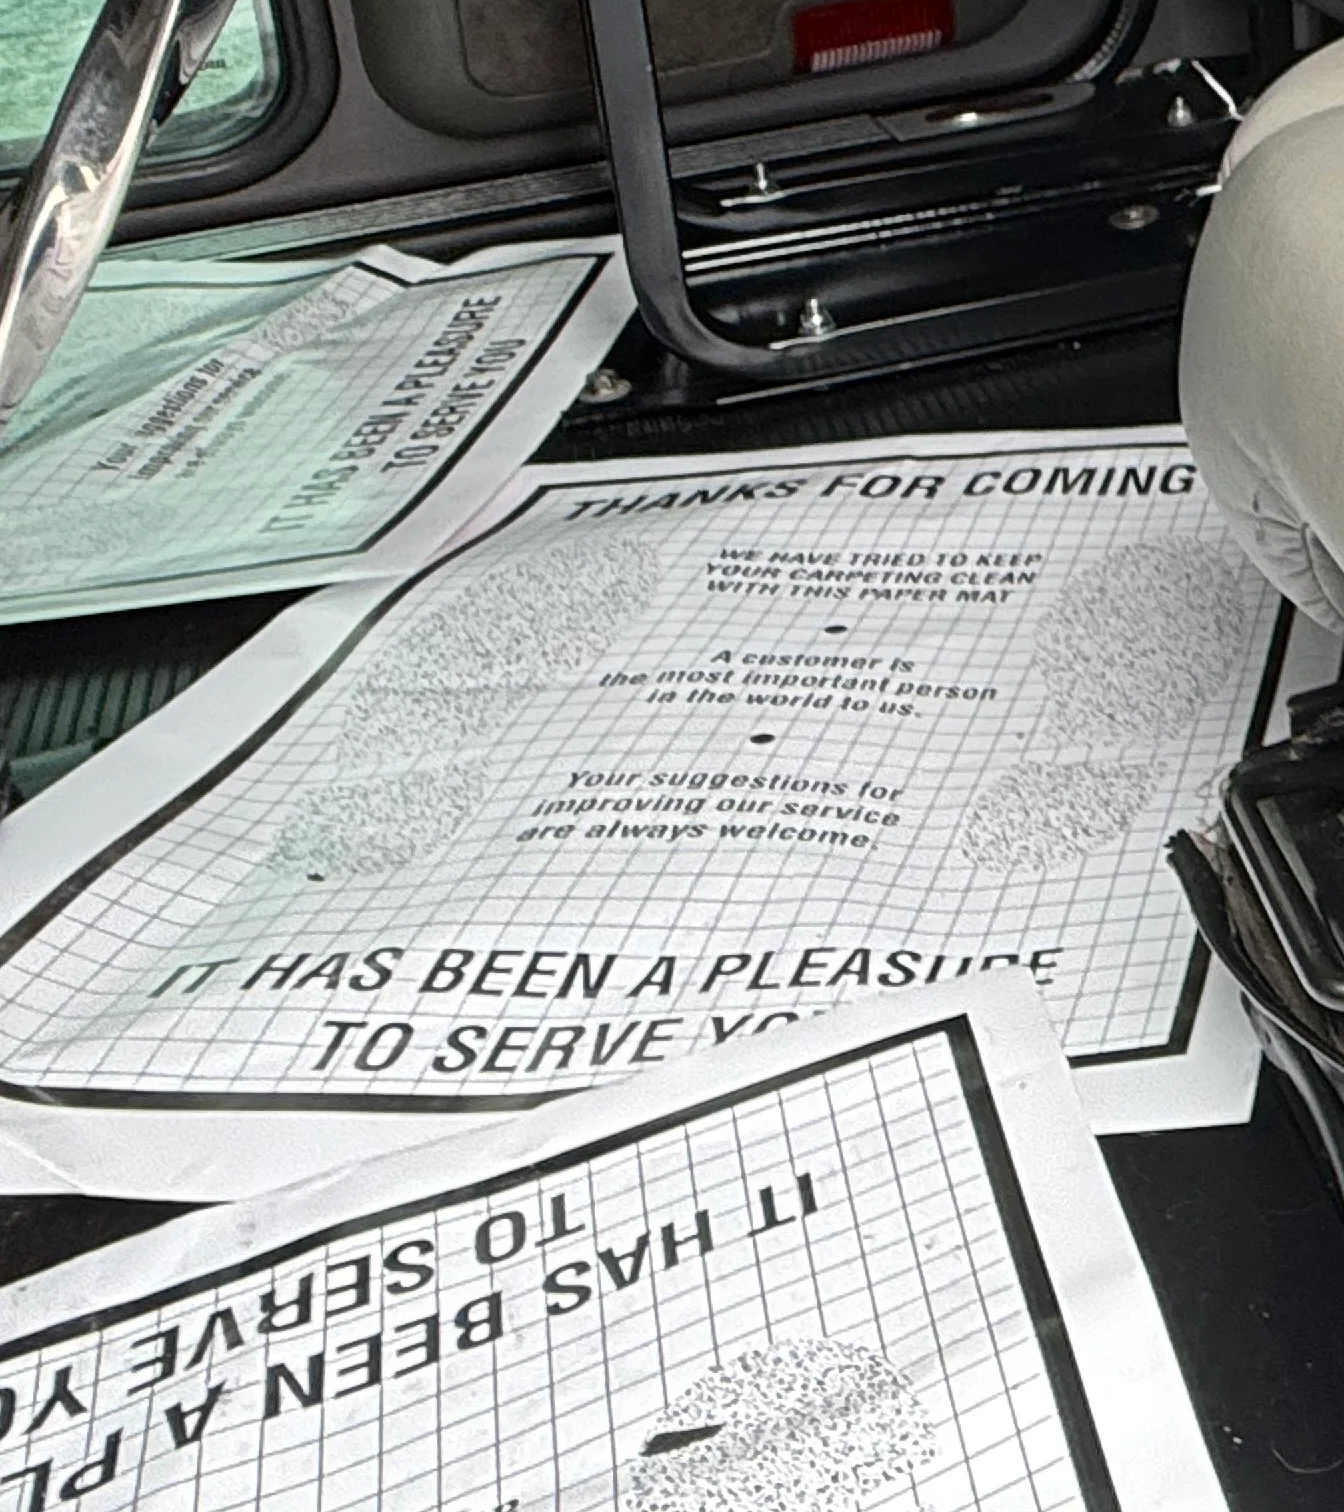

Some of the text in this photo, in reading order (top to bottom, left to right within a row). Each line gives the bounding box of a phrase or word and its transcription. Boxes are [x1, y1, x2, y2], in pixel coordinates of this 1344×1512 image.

[257, 296, 502, 533] IT HAS BEEN A PLEASURE
[380, 339, 527, 473] TO SERVE YOU
[564, 464, 1197, 522] THANKS FOR COMING
[706, 562, 1038, 585] YOUR CARPETING CLEAN
[719, 548, 1043, 568] WE HAVE TRIED TO KEEP
[706, 579, 1013, 604] WITH THIS PAPER MAT
[598, 669, 998, 701] the most important person
[710, 649, 916, 673] A customer is
[645, 689, 922, 718] in the world to us.
[531, 795, 901, 827] improving our service
[566, 770, 904, 803] Your suggestions for
[515, 819, 881, 851] are always welcome.
[147, 957, 239, 999] IT
[239, 946, 407, 991] HAS
[417, 948, 620, 999] BEEN
[625, 954, 679, 998] A
[311, 1019, 415, 1073] TO
[431, 1015, 685, 1074] SERVE
[474, 1192, 587, 1265] TO
[747, 1171, 819, 1238] IT
[541, 1208, 716, 1316] HAS
[126, 1238, 436, 1397] SERVE
[262, 1290, 504, 1420] BEEN
[164, 1379, 228, 1450] A
